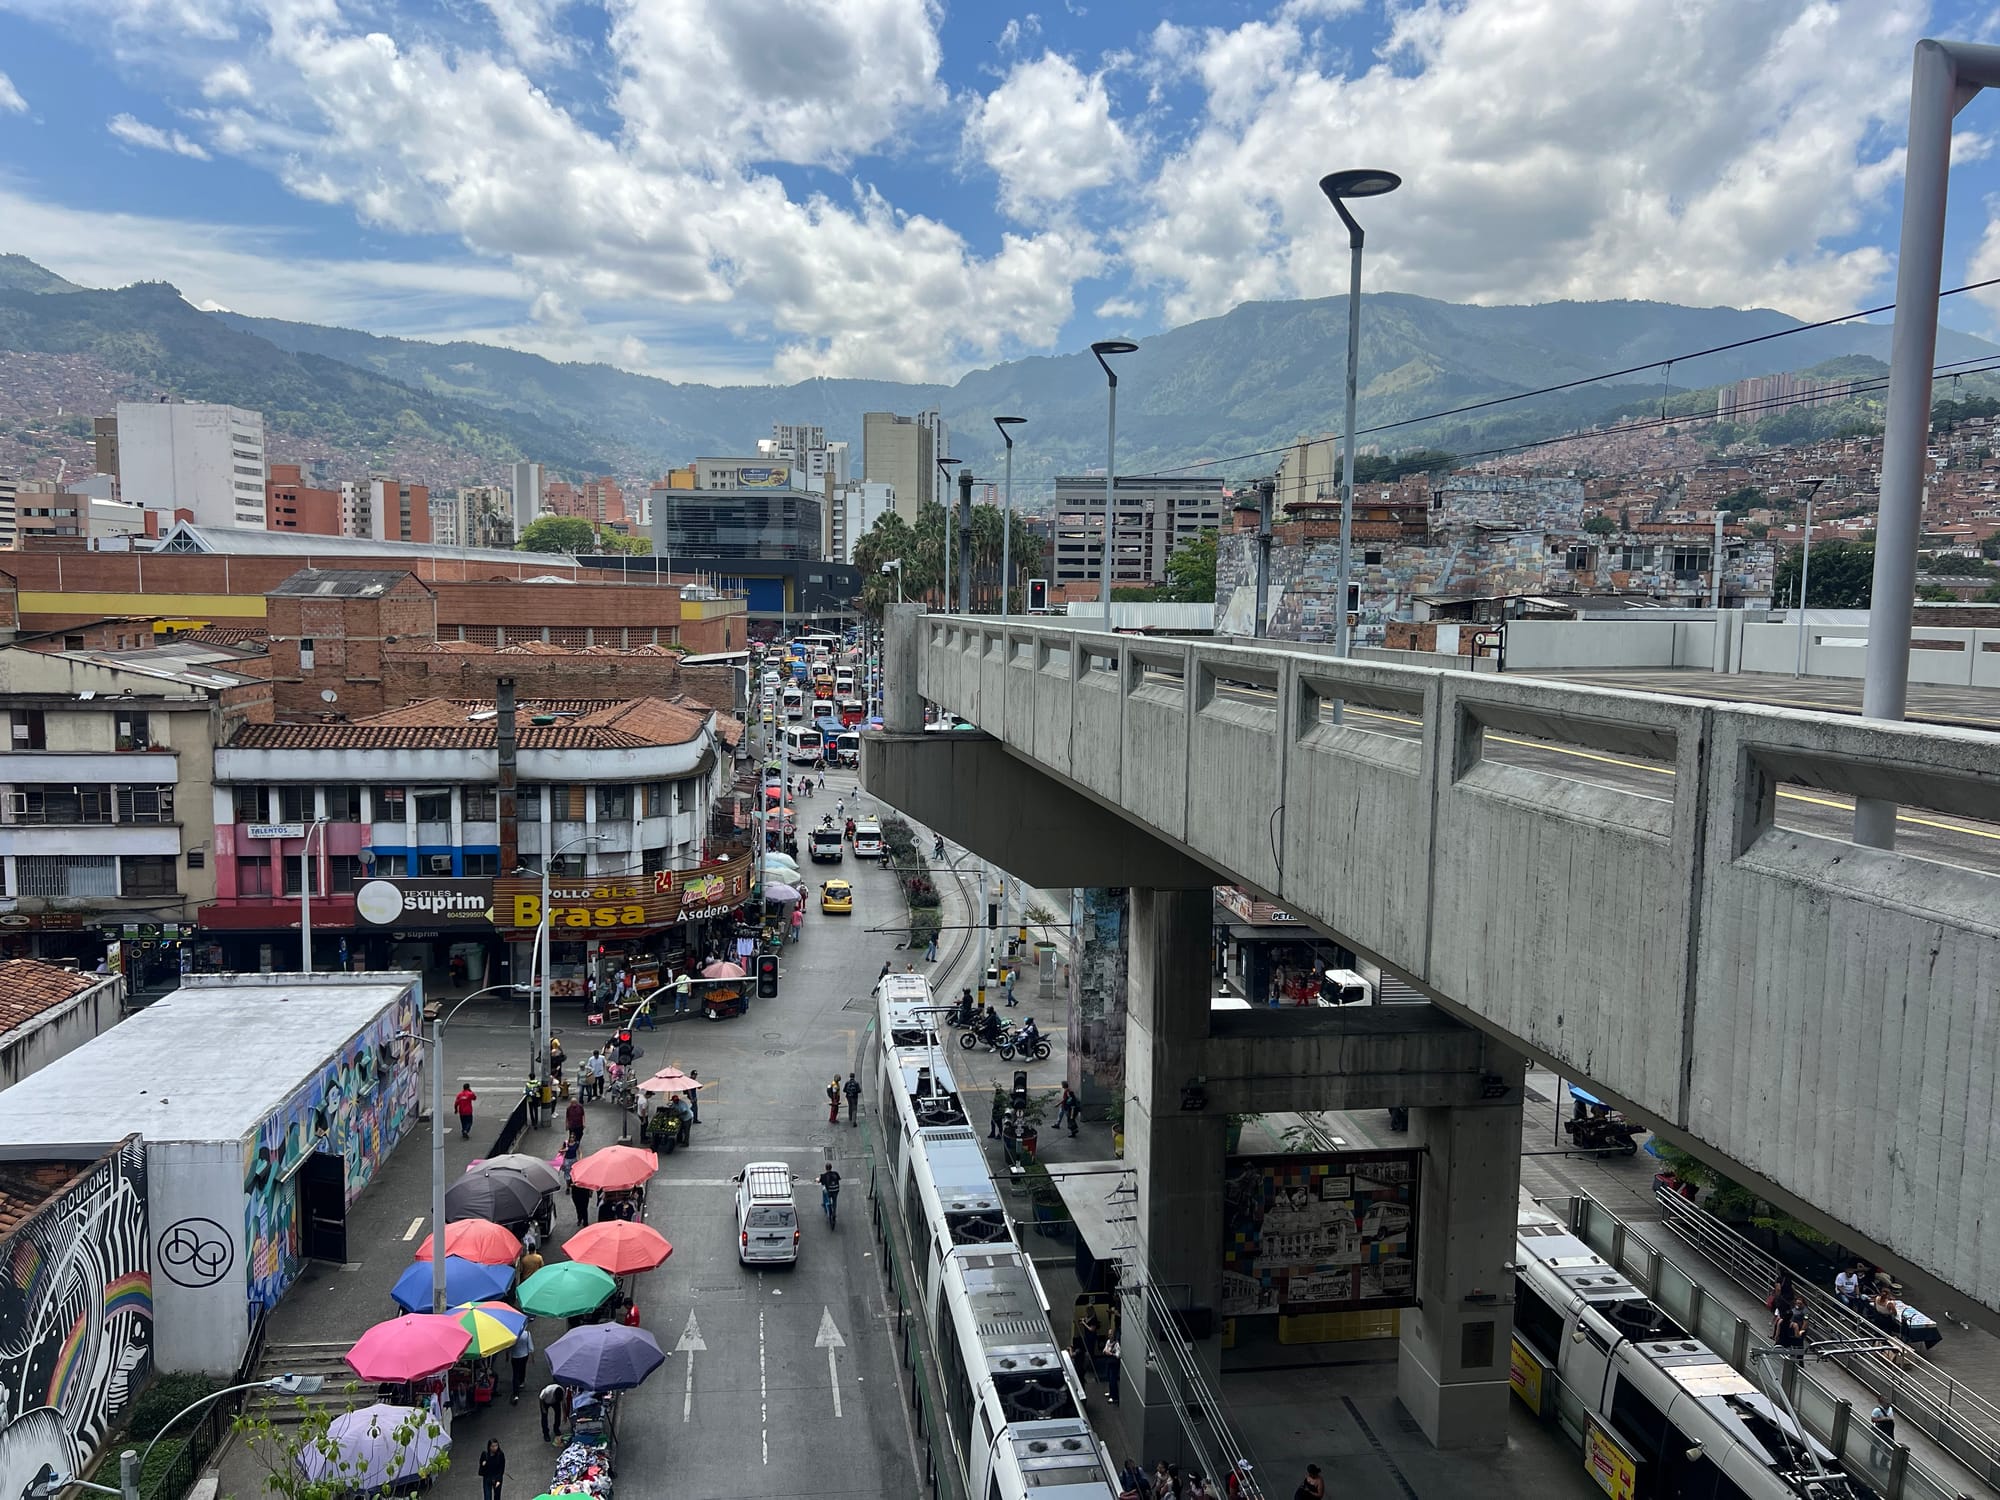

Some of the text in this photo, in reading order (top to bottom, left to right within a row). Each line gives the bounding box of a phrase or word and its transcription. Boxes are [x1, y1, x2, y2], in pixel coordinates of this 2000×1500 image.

[655, 870, 672, 893] 24
[404, 892, 484, 914] suprim
[548, 888, 590, 898] OLLO
[514, 895, 645, 926] Brasa
[677, 905, 728, 922] Asadero
[1273, 912, 1297, 920] PETE
[61, 1165, 108, 1217] DOURONE
